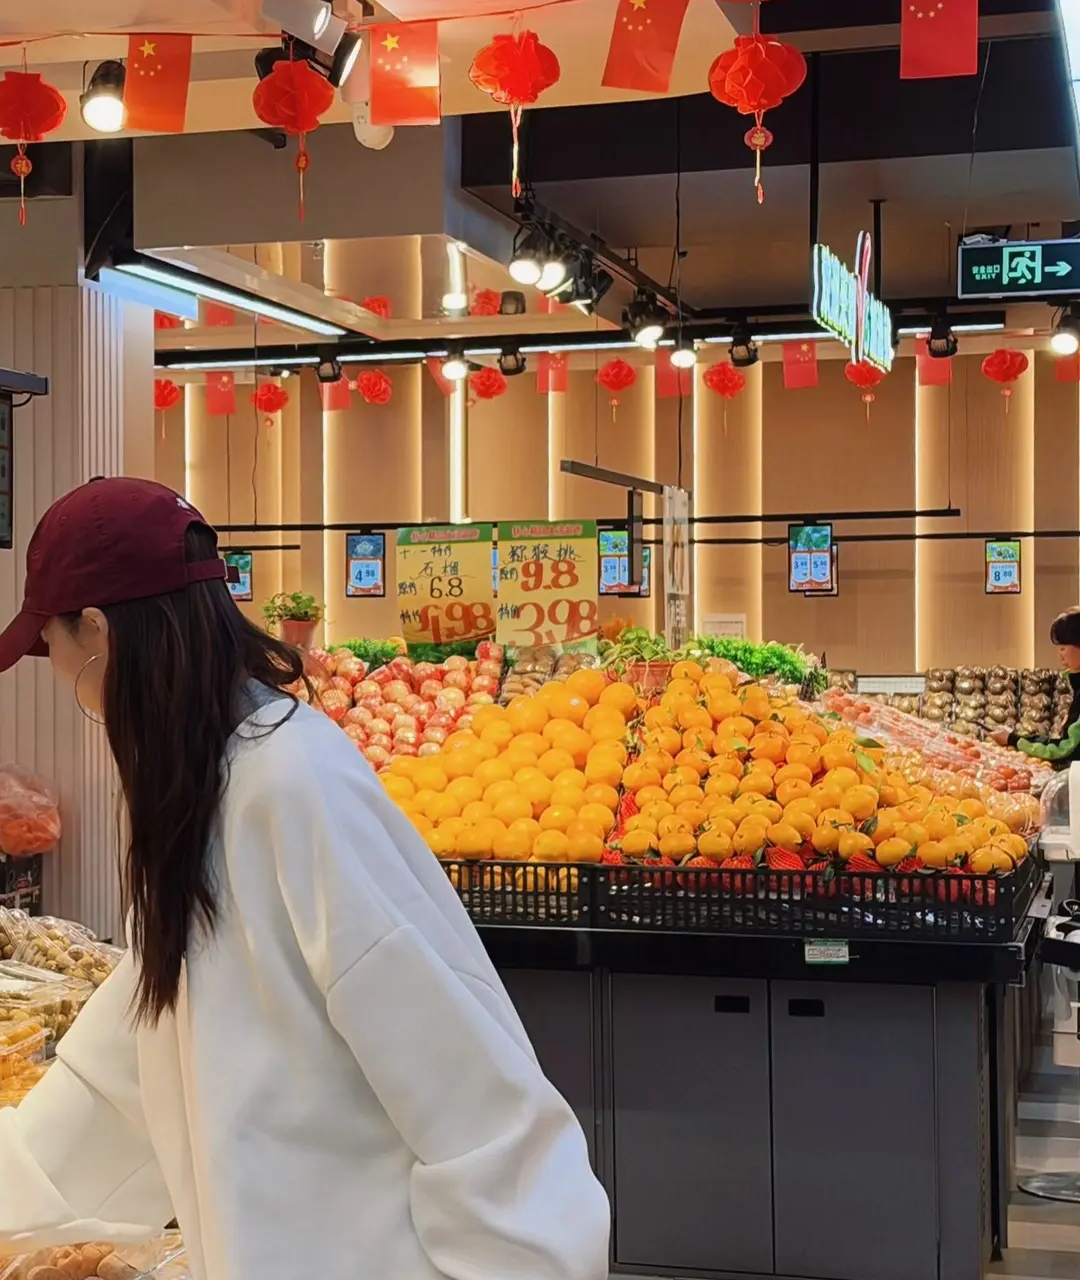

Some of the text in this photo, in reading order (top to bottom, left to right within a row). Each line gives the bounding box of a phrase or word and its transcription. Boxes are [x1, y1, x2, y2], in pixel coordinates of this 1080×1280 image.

[975, 273, 997, 281] EXIT
[520, 559, 579, 592] 9.8
[429, 576, 464, 599] 6.8
